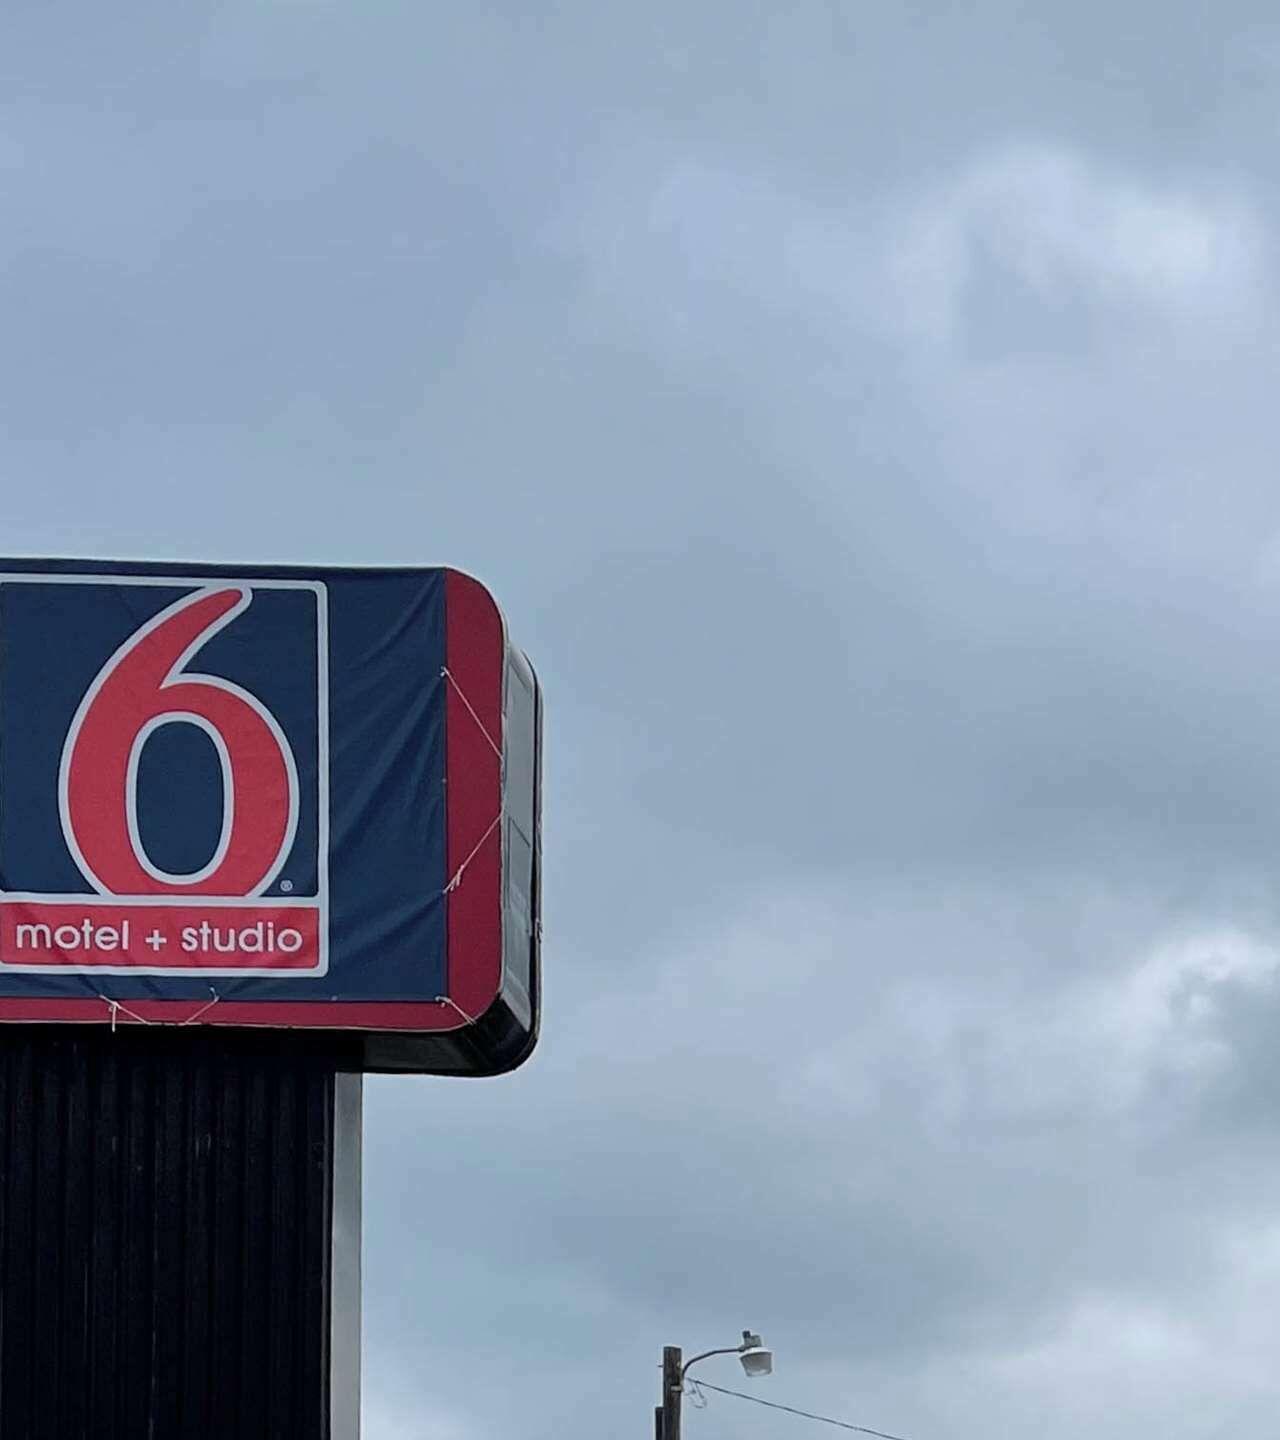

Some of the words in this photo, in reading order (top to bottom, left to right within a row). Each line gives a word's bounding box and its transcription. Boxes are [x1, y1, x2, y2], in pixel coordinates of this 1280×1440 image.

[58, 584, 300, 897] 6
[15, 919, 130, 951] motel
[181, 920, 304, 953] studio
